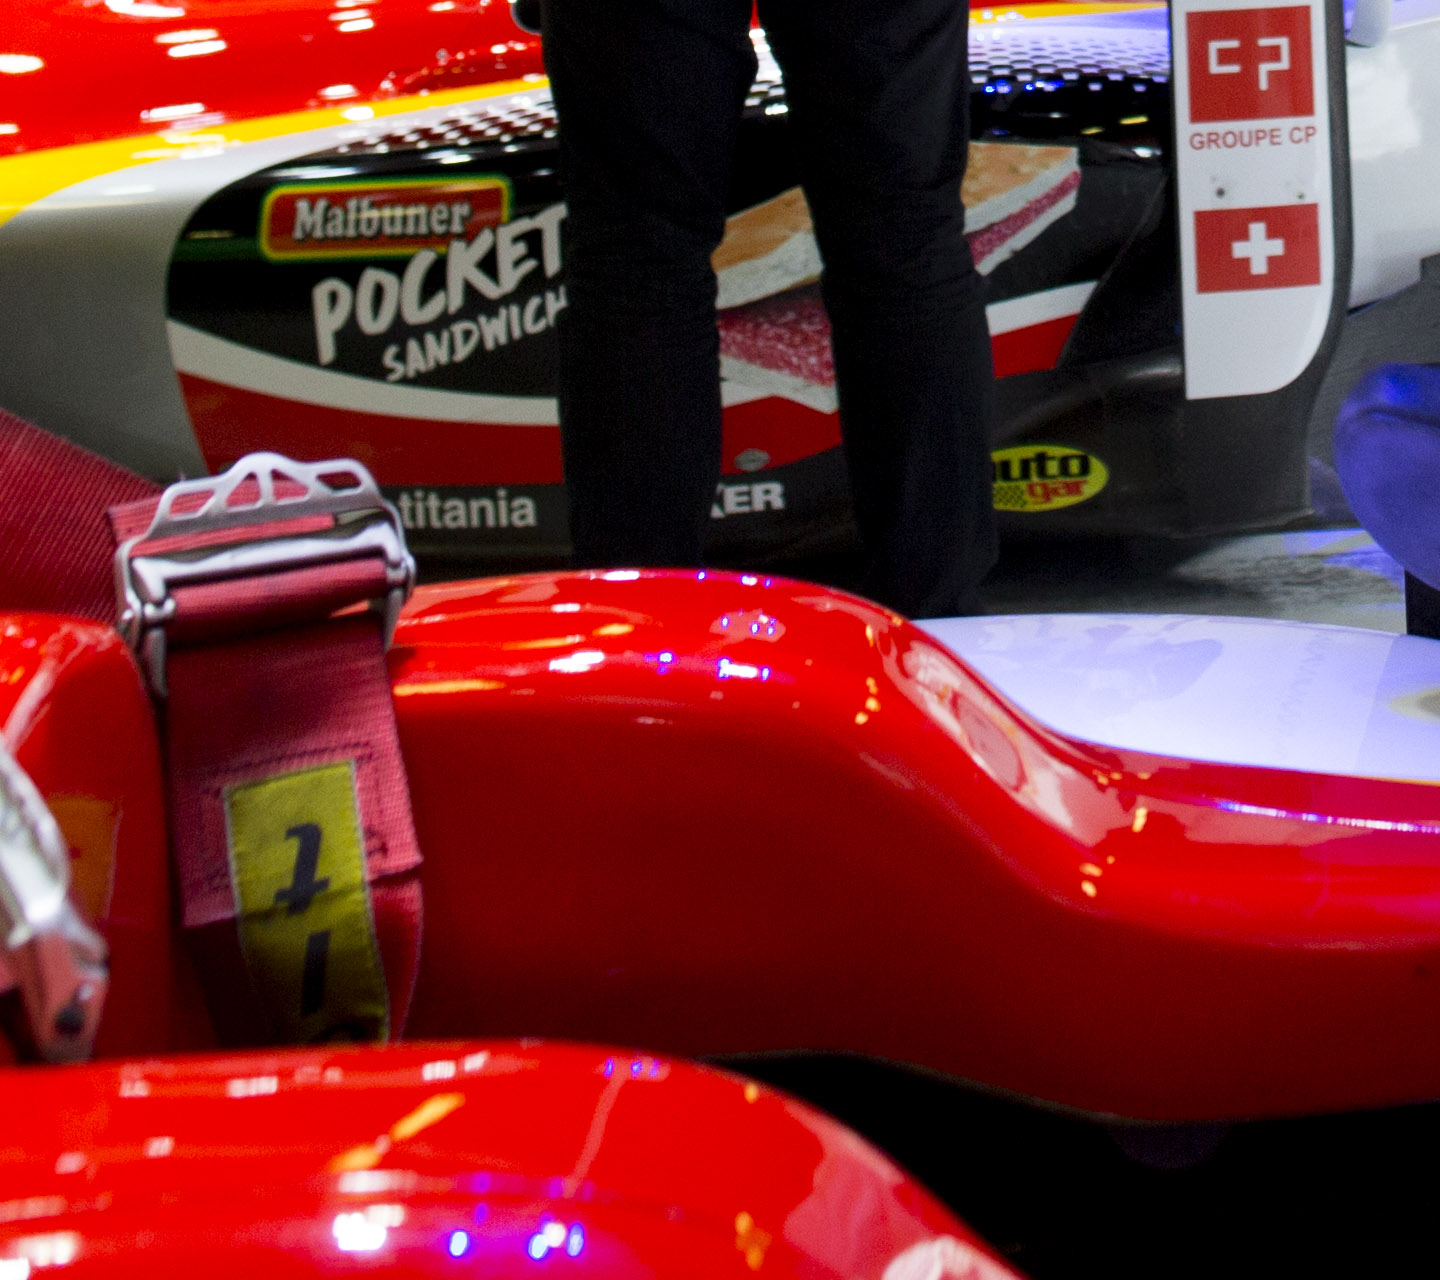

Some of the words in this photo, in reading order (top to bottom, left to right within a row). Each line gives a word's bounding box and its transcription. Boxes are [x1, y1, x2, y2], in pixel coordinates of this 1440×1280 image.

[1189, 128, 1282, 150] GROUPE
[1289, 126, 1317, 144] CP
[292, 196, 472, 241] Malbuner
[312, 201, 568, 366] POCKET
[1027, 480, 1088, 505] gar
